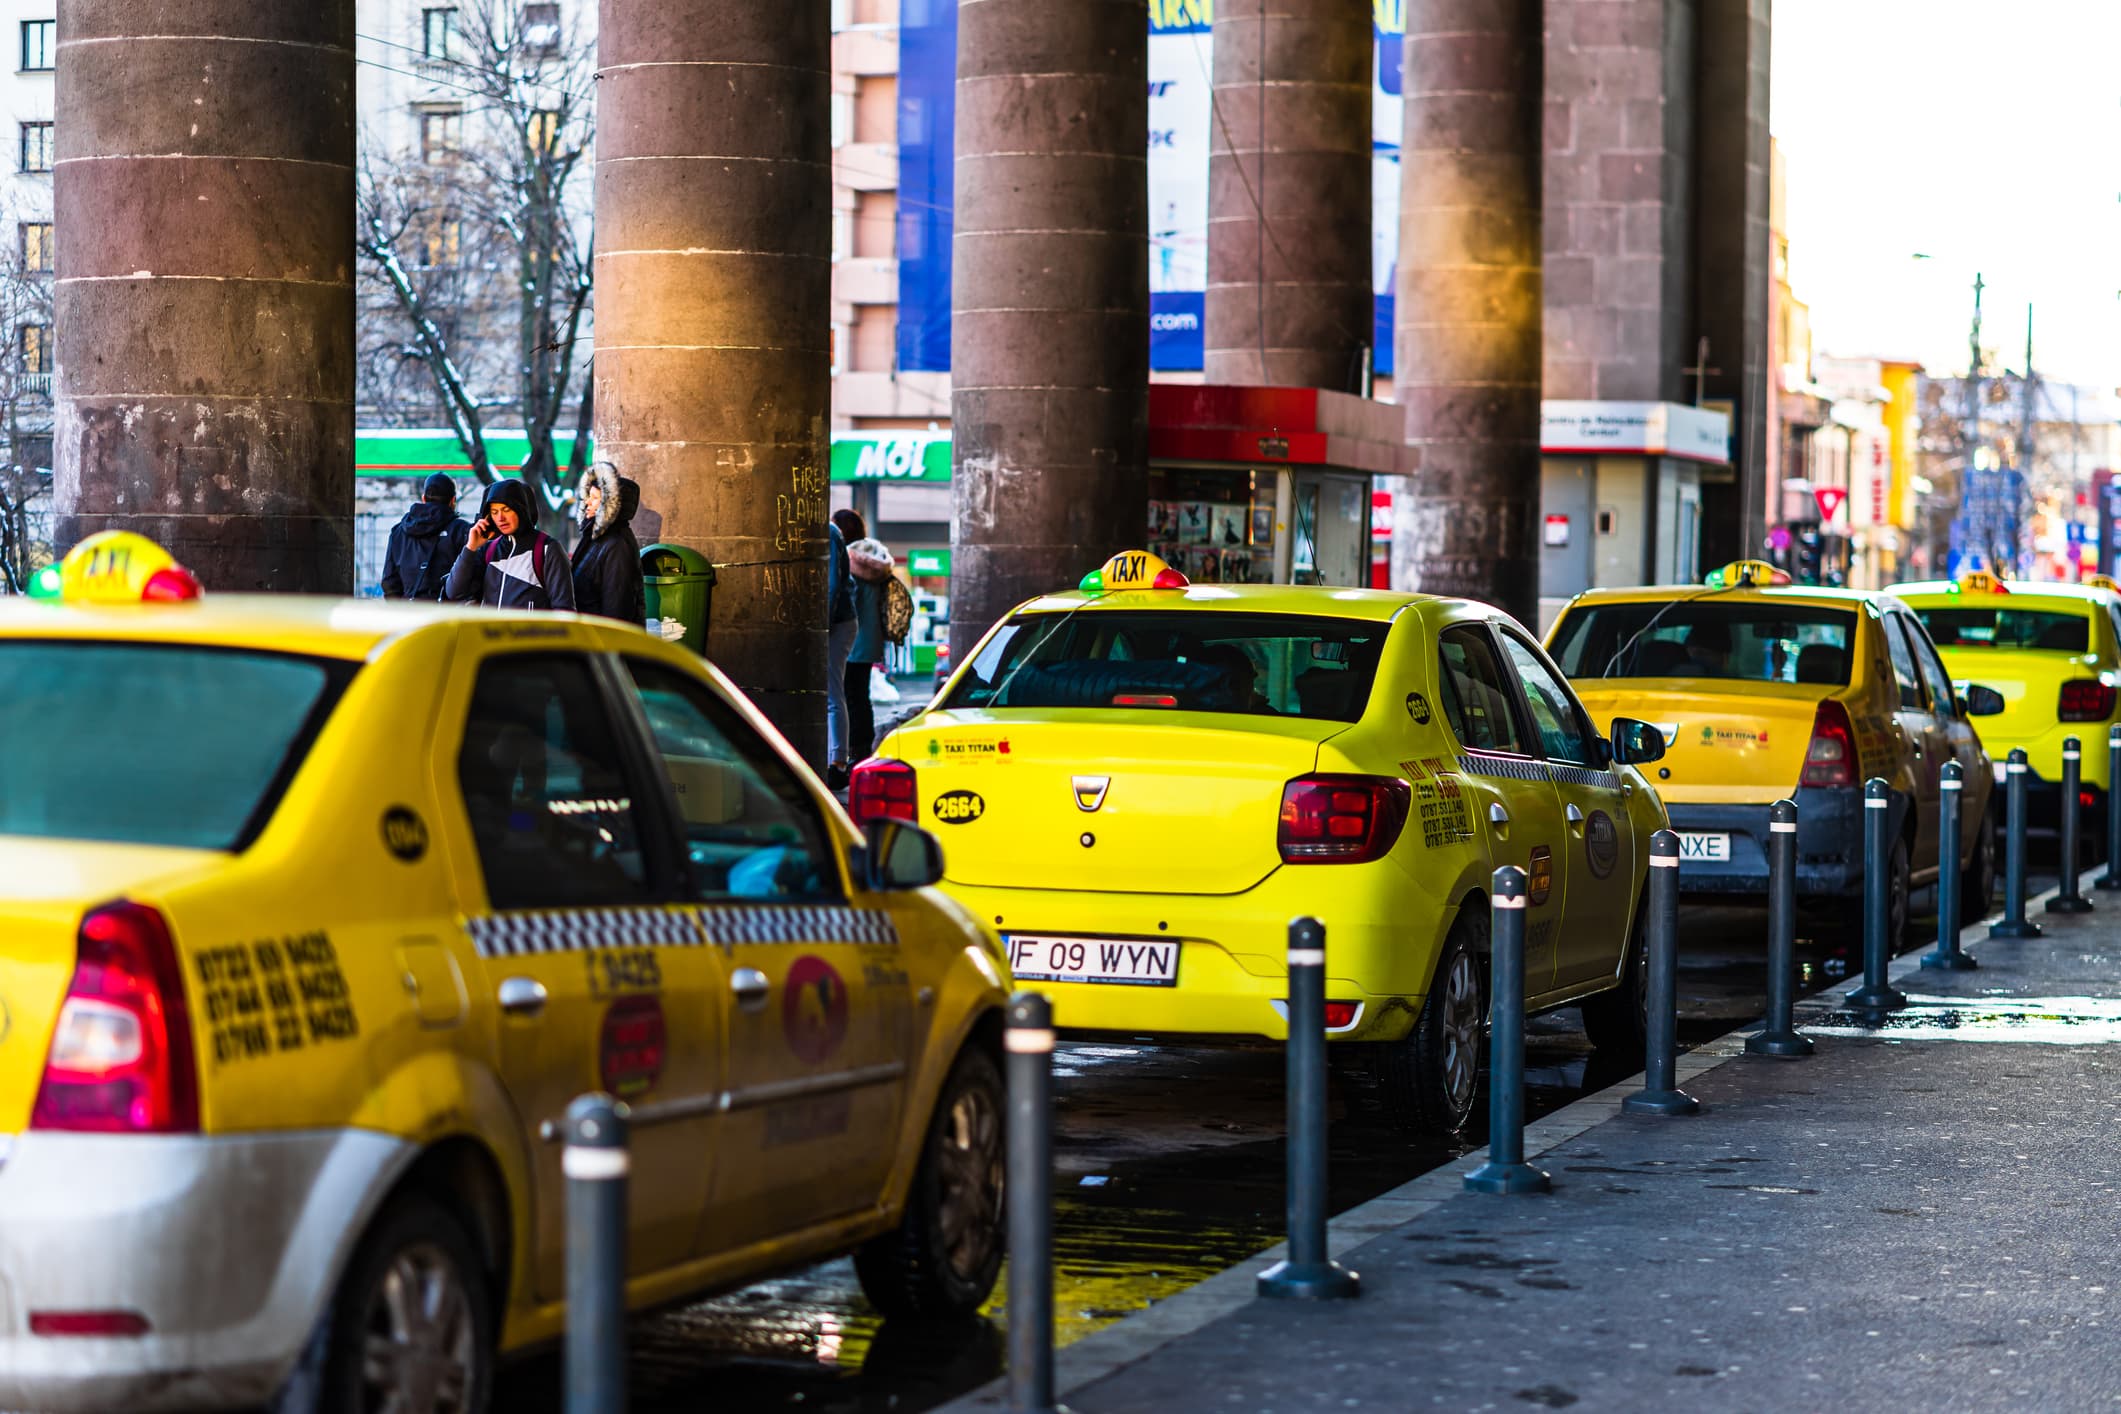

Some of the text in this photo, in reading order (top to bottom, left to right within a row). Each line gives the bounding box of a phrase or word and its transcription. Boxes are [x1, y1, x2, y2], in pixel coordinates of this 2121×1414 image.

[1112, 556, 1146, 582] TAXI
[945, 744, 996, 753] TAXI TITAN
[936, 796, 981, 818] 2664
[1050, 942, 1085, 971] 09
[1100, 943, 1170, 975] WYN
